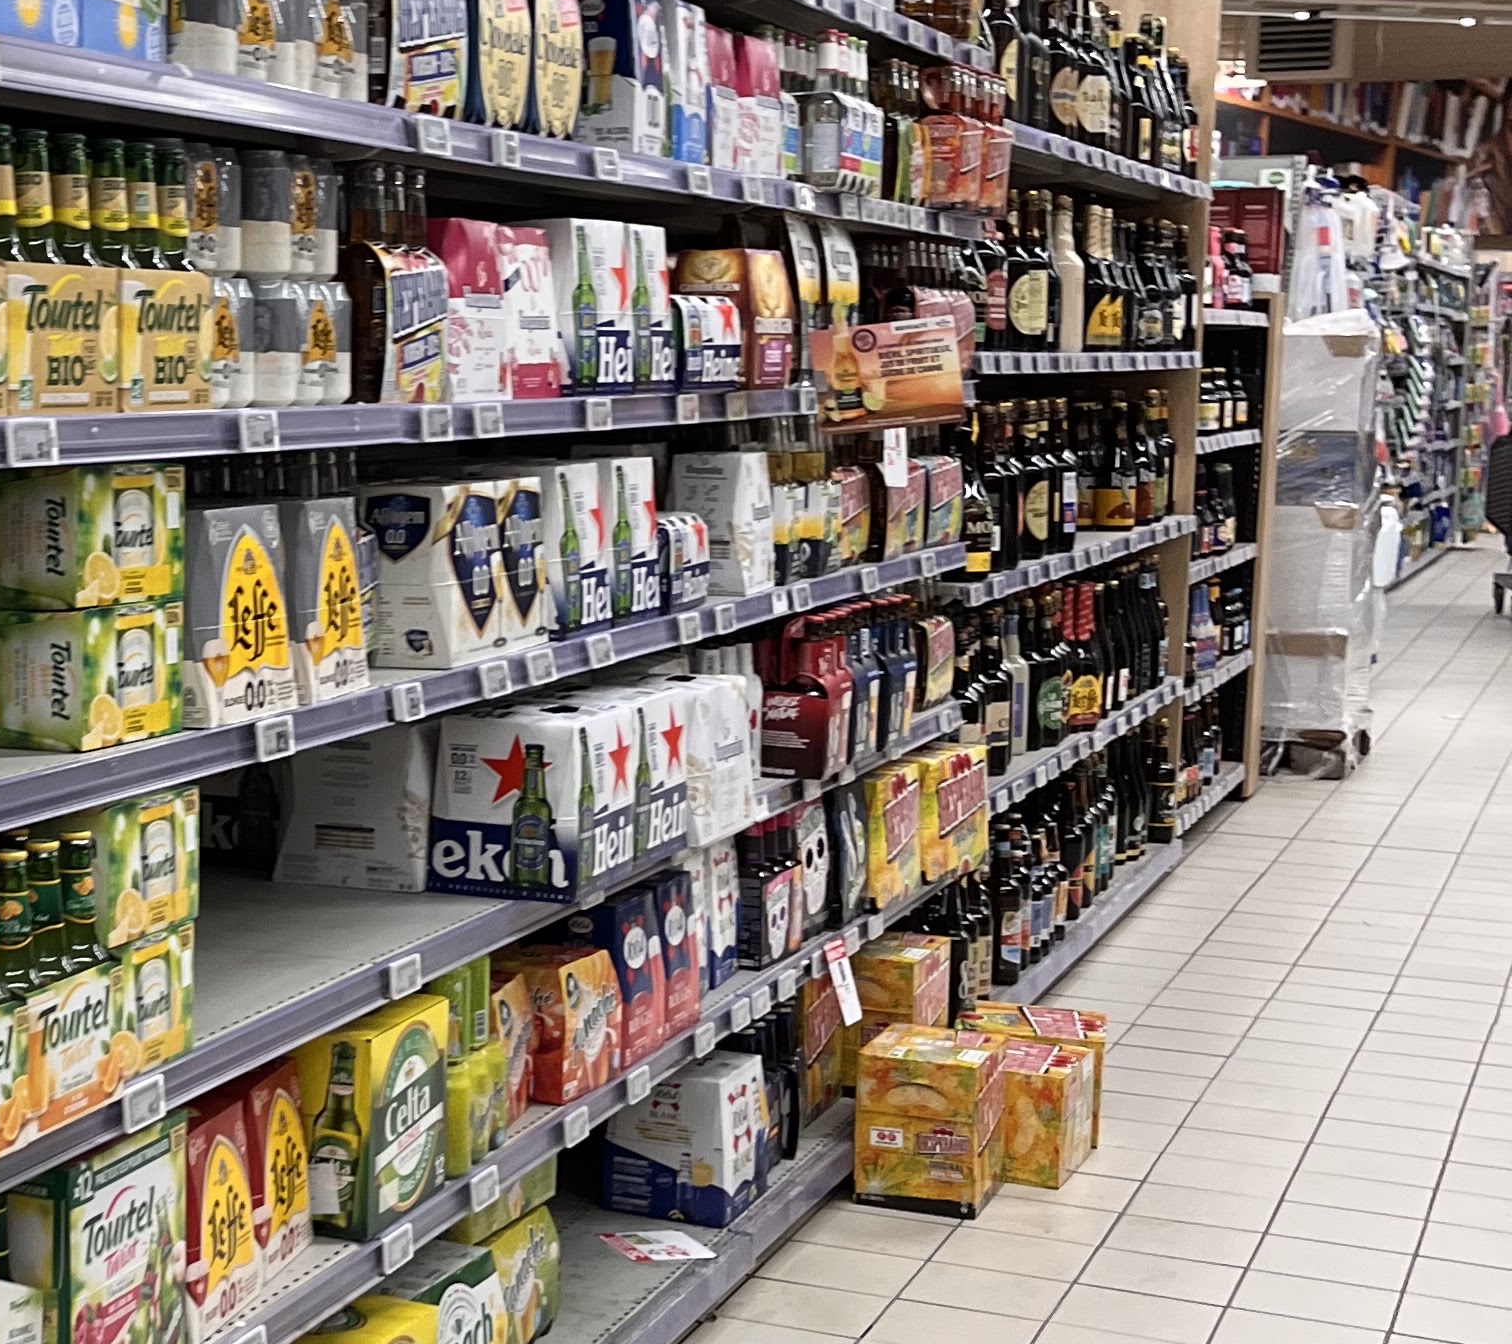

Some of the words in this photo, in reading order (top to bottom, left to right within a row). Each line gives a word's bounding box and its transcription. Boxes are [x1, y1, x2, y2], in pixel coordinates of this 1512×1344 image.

[23, 284, 104, 331] Tourtel
[135, 289, 202, 335] Tourtel
[46, 355, 86, 387] BIO
[153, 355, 188, 385] BIO
[44, 495, 67, 577] Tourtel
[227, 579, 278, 662] Leffe
[49, 640, 72, 721] Tourtel
[38, 985, 111, 1057] Tourtel
[384, 1082, 432, 1143] Celta
[270, 1136, 307, 1214] Leffe
[82, 1185, 156, 1266] Tourtel
[208, 1188, 249, 1273] Leffe
